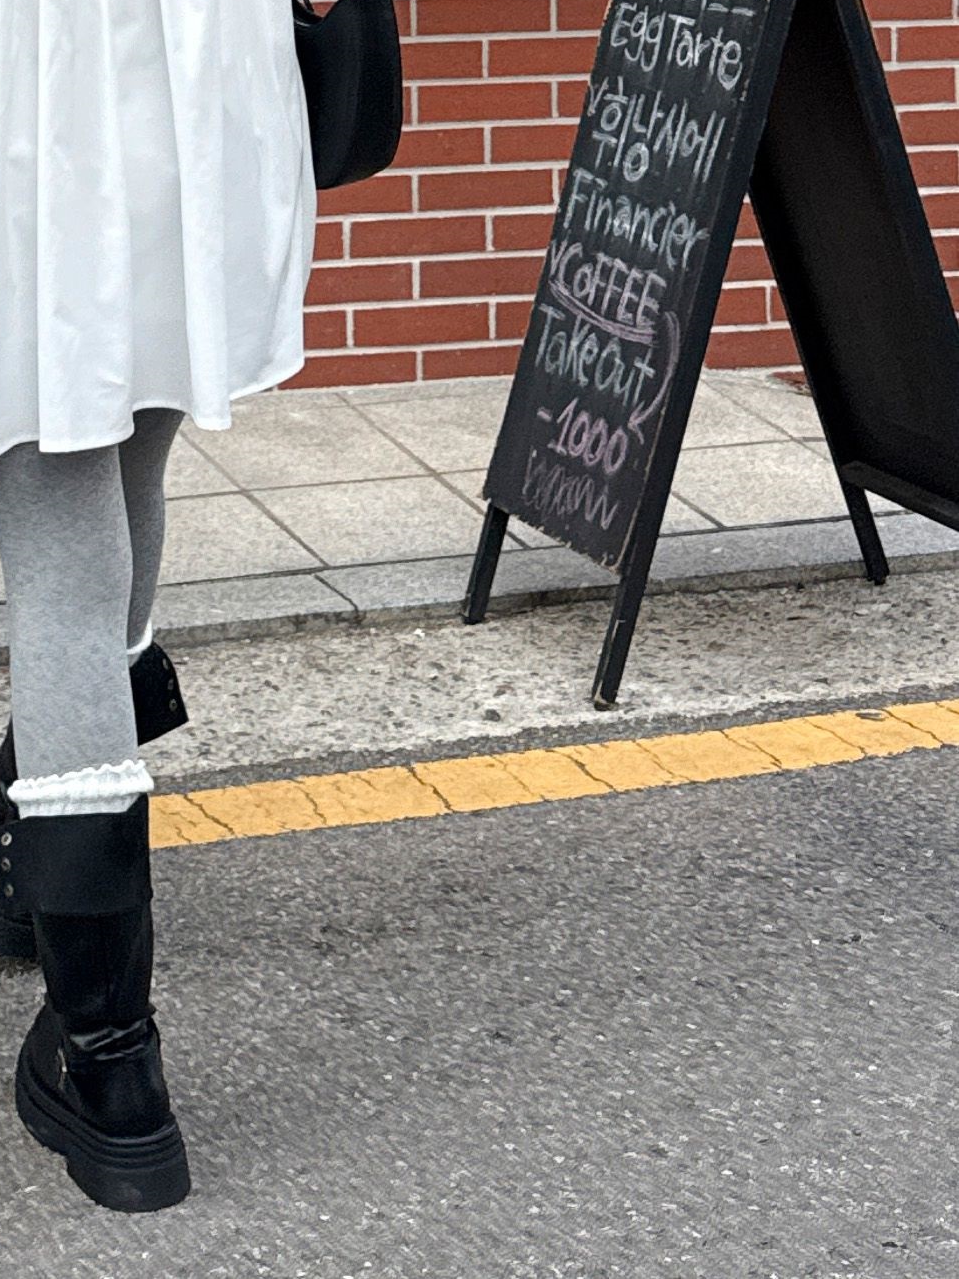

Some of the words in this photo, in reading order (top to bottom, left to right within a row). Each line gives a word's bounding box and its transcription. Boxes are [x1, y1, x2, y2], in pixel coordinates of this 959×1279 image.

[592, 76, 726, 183] 휘낭시에
[563, 168, 710, 270] Financier
[536, 397, 629, 476] -1000
